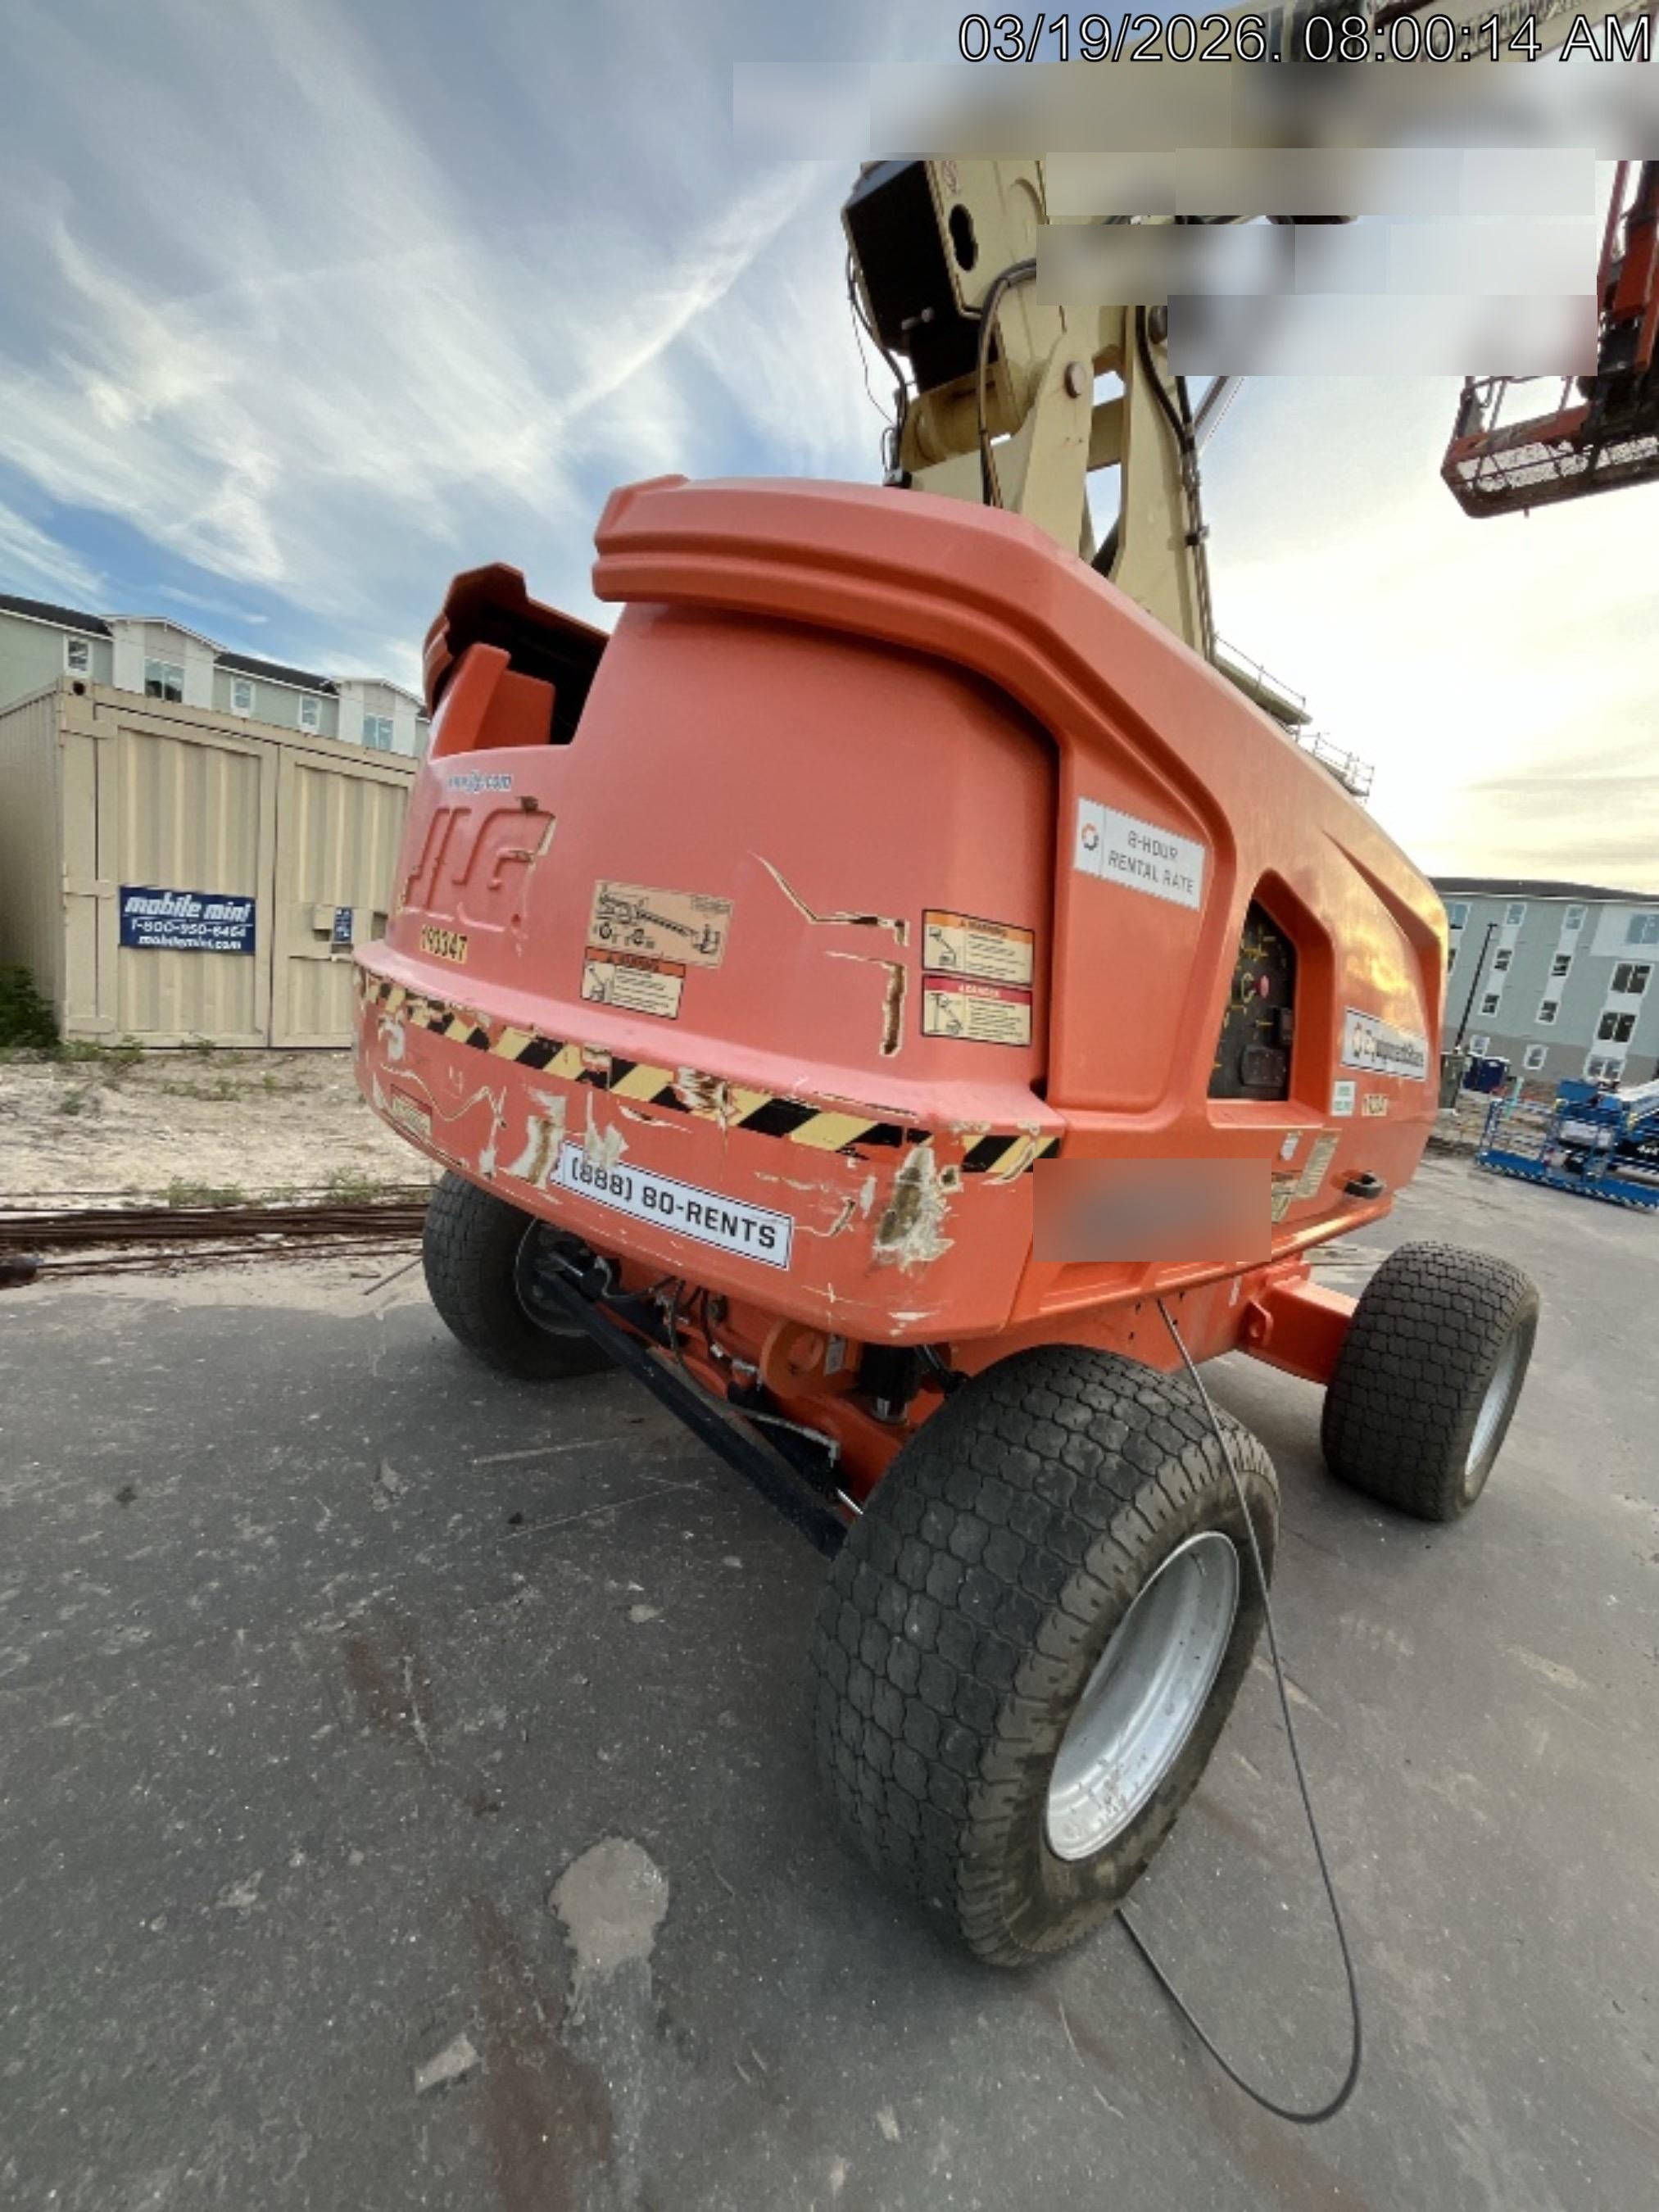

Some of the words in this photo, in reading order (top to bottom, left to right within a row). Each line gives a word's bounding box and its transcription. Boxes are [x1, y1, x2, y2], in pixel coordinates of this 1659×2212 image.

[1108, 849, 1158, 883] RENTAL
[1162, 868, 1194, 895] RATE
[125, 891, 202, 918] mobile
[571, 1156, 632, 1202] (888)
